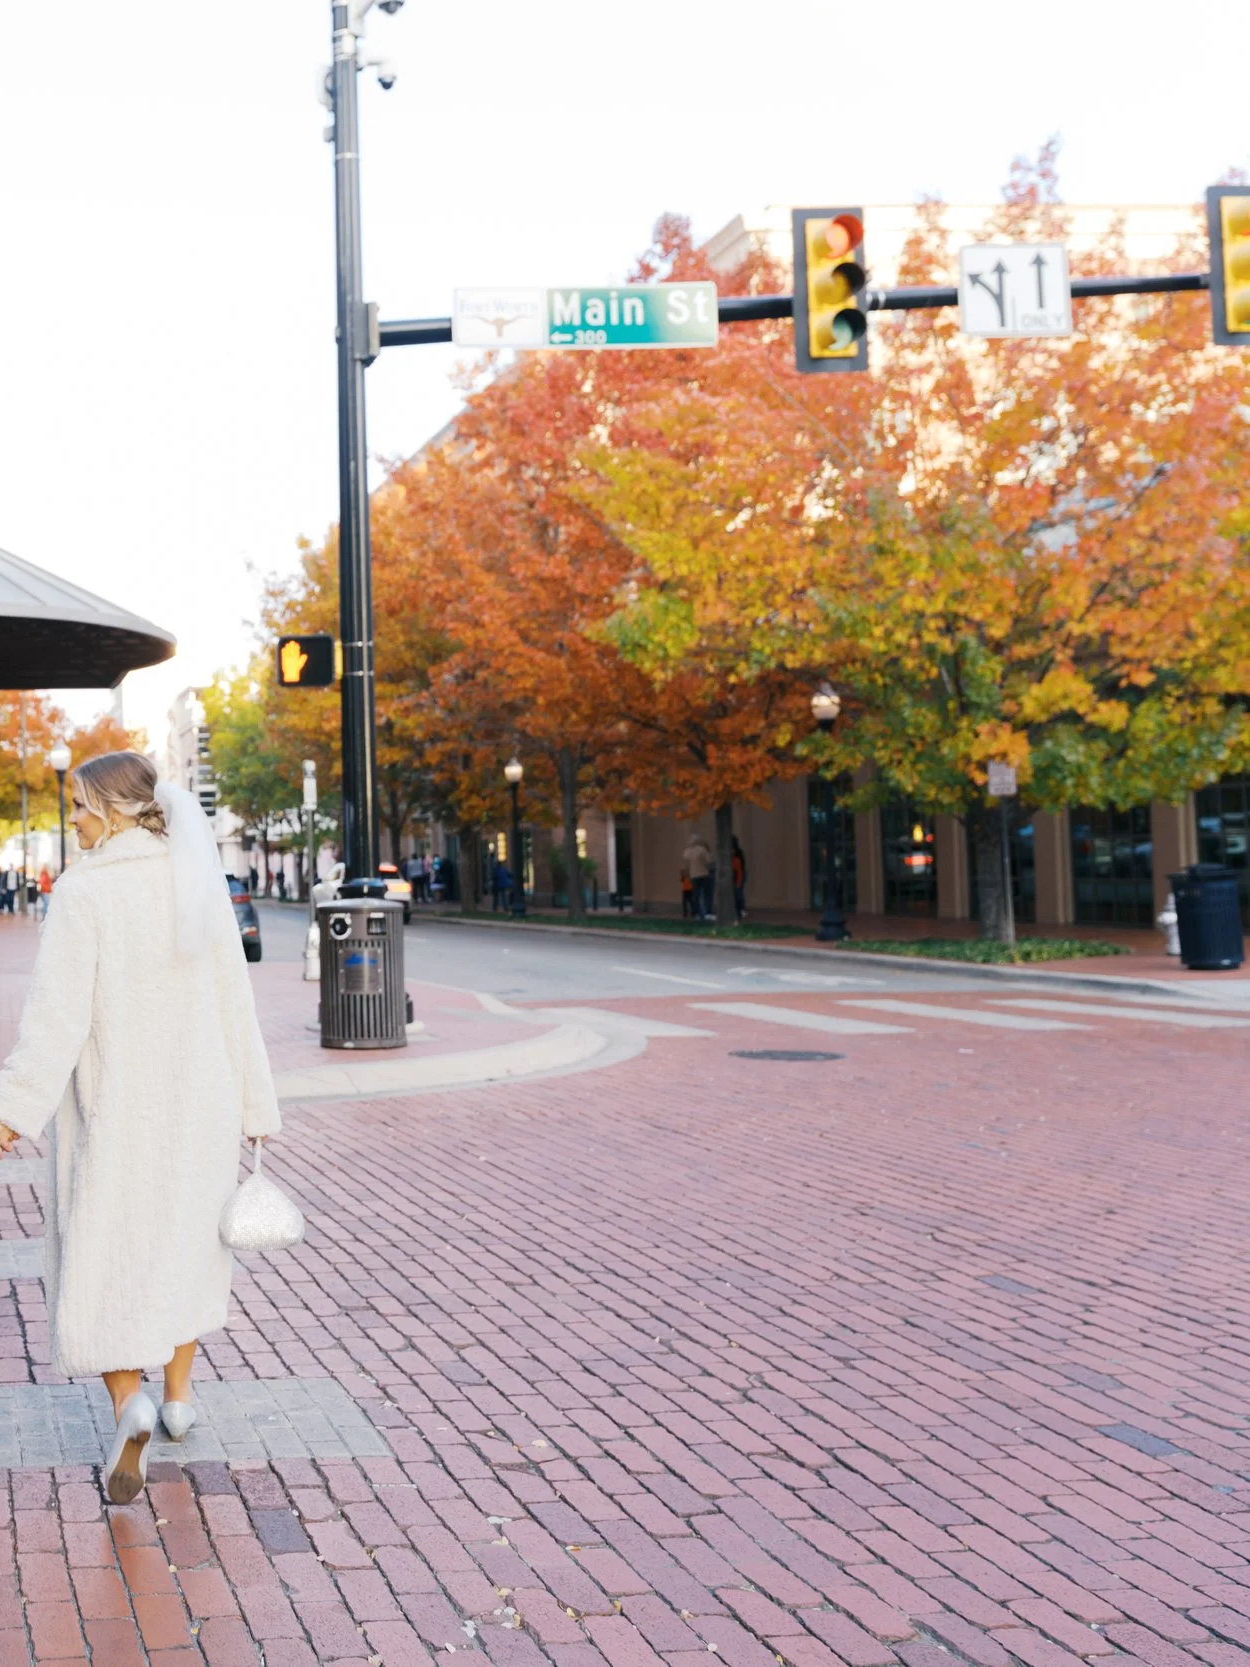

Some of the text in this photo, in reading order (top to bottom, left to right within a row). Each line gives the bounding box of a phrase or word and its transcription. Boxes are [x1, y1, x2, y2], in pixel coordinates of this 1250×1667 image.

[552, 289, 710, 327] Main St
[1021, 313, 1063, 328] ONLY
